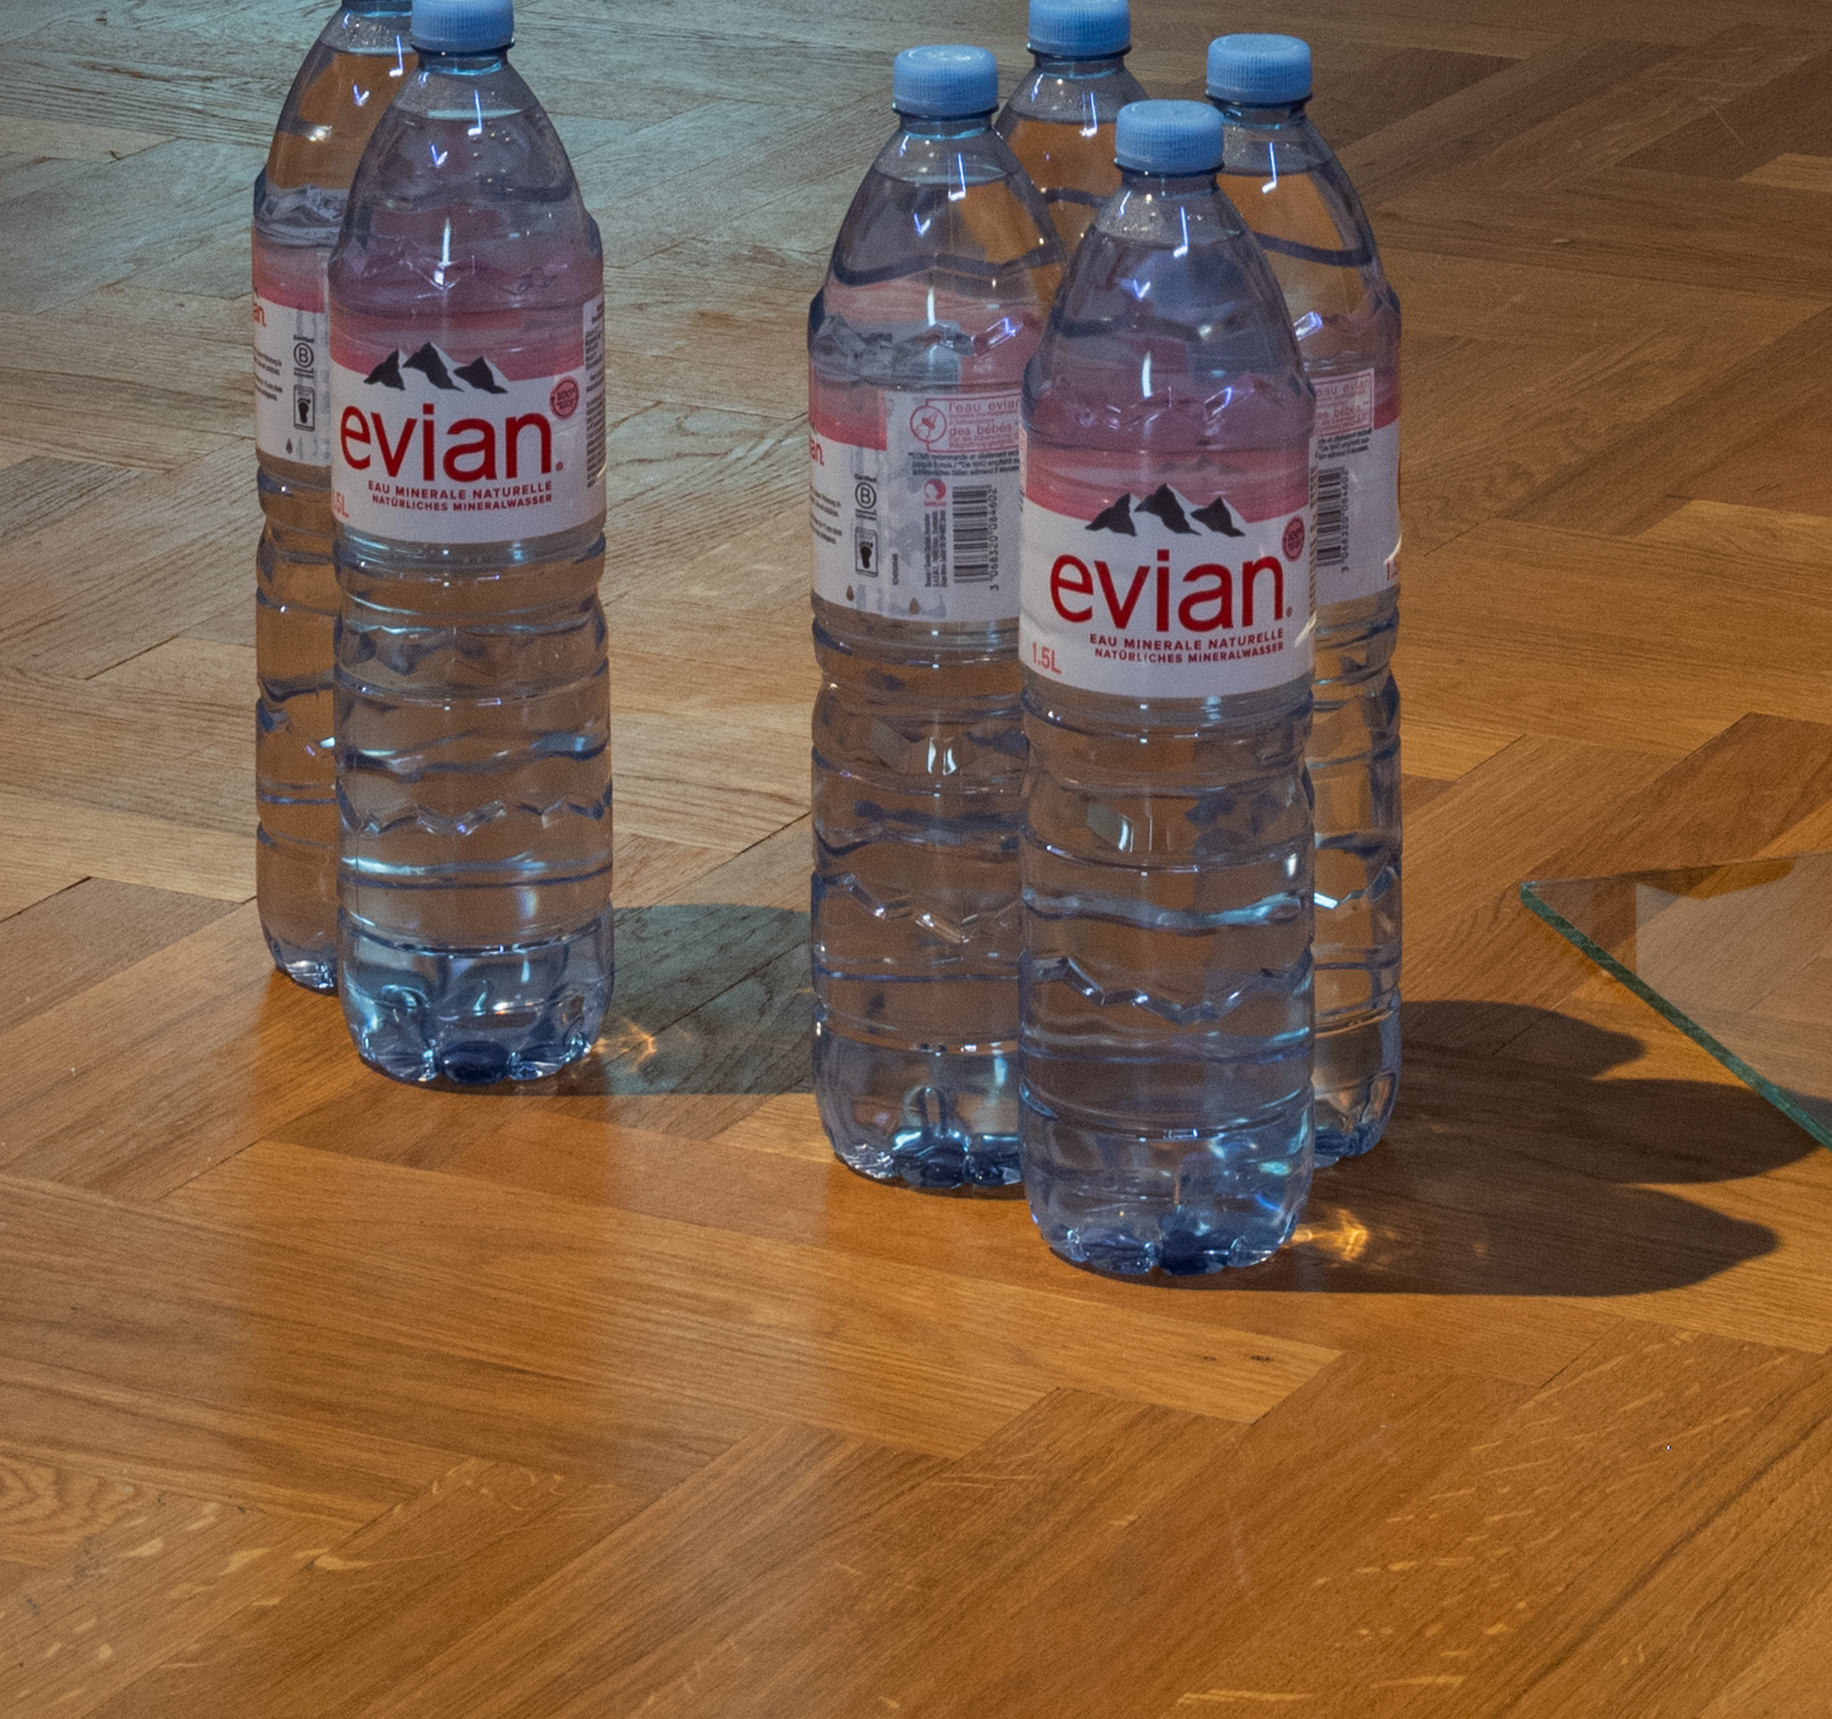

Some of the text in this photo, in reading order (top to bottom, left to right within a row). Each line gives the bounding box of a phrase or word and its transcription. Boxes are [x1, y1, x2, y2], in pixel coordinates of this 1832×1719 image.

[340, 403, 552, 483] evian
[368, 479, 552, 501] EAU MINERALE NATURELLE
[372, 493, 552, 512] NATÜRLICHES MINERALWASSER
[1050, 549, 1284, 633] evian
[1089, 628, 1284, 651] EAU MINERALE NATURELLE
[1032, 641, 1062, 675] 1.5L
[1094, 641, 1284, 664] NATÜRLICHES MINERALWASSER
